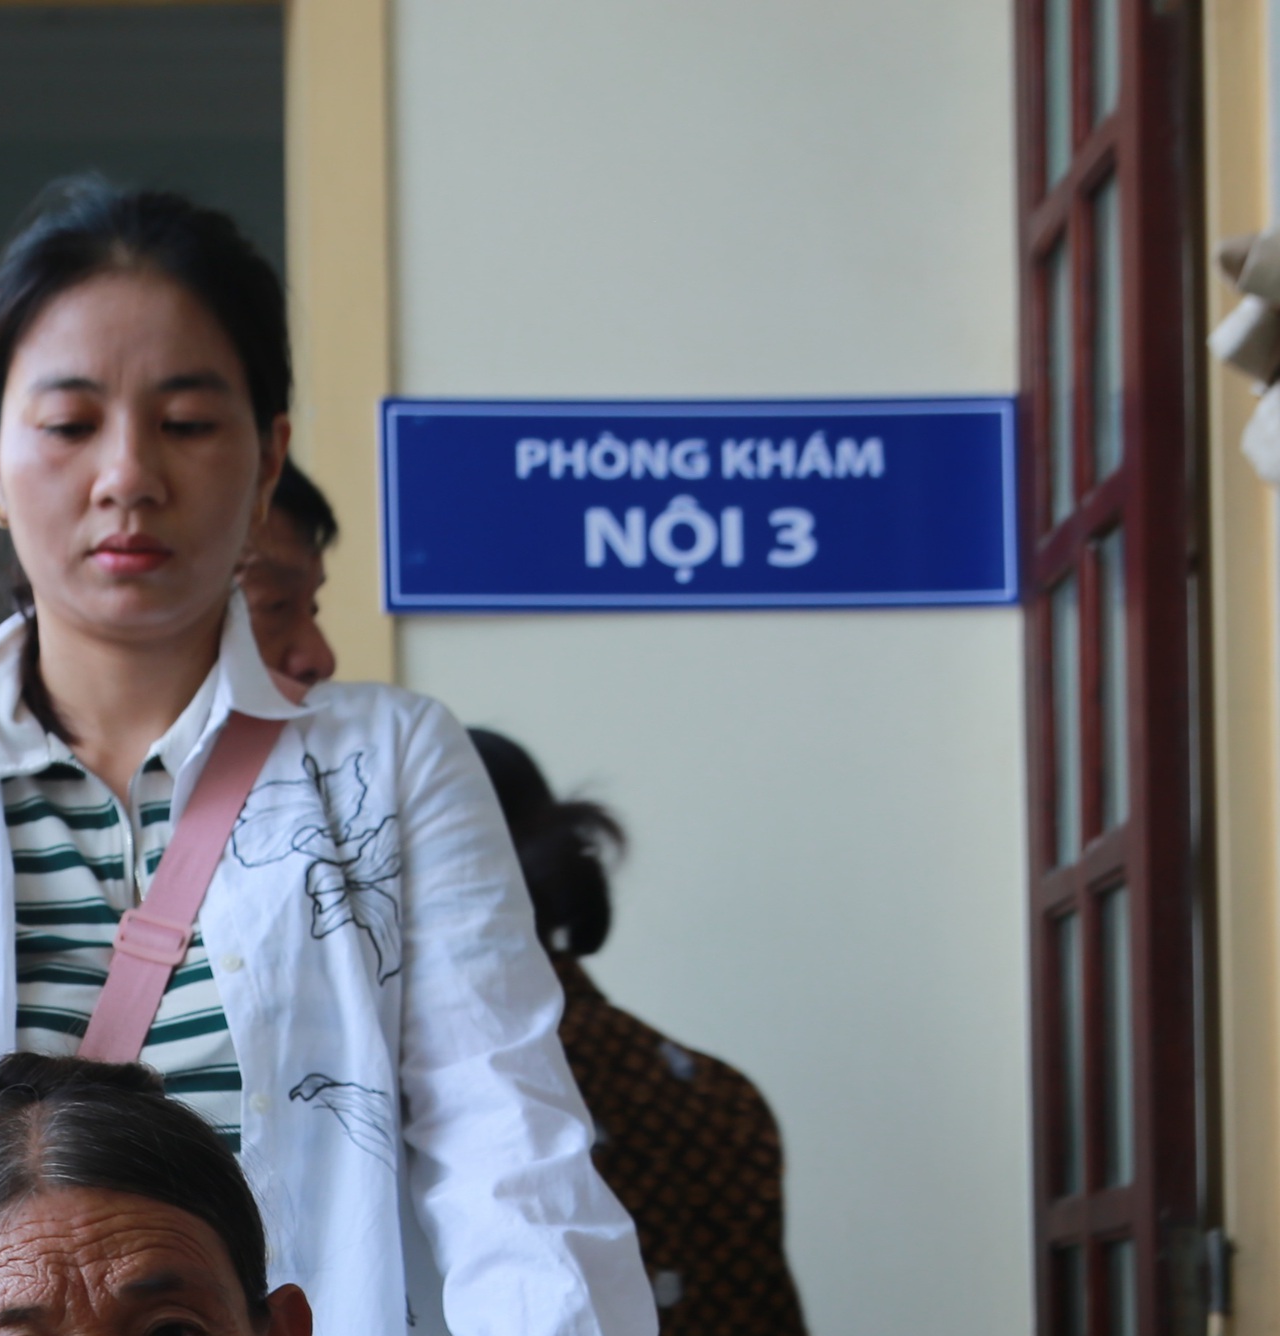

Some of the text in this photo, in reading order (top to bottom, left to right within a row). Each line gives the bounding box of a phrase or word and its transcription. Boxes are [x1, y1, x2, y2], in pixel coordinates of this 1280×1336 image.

[514, 430, 886, 480] PHÒNG KHÁM
[583, 493, 818, 584] NỘI 3
